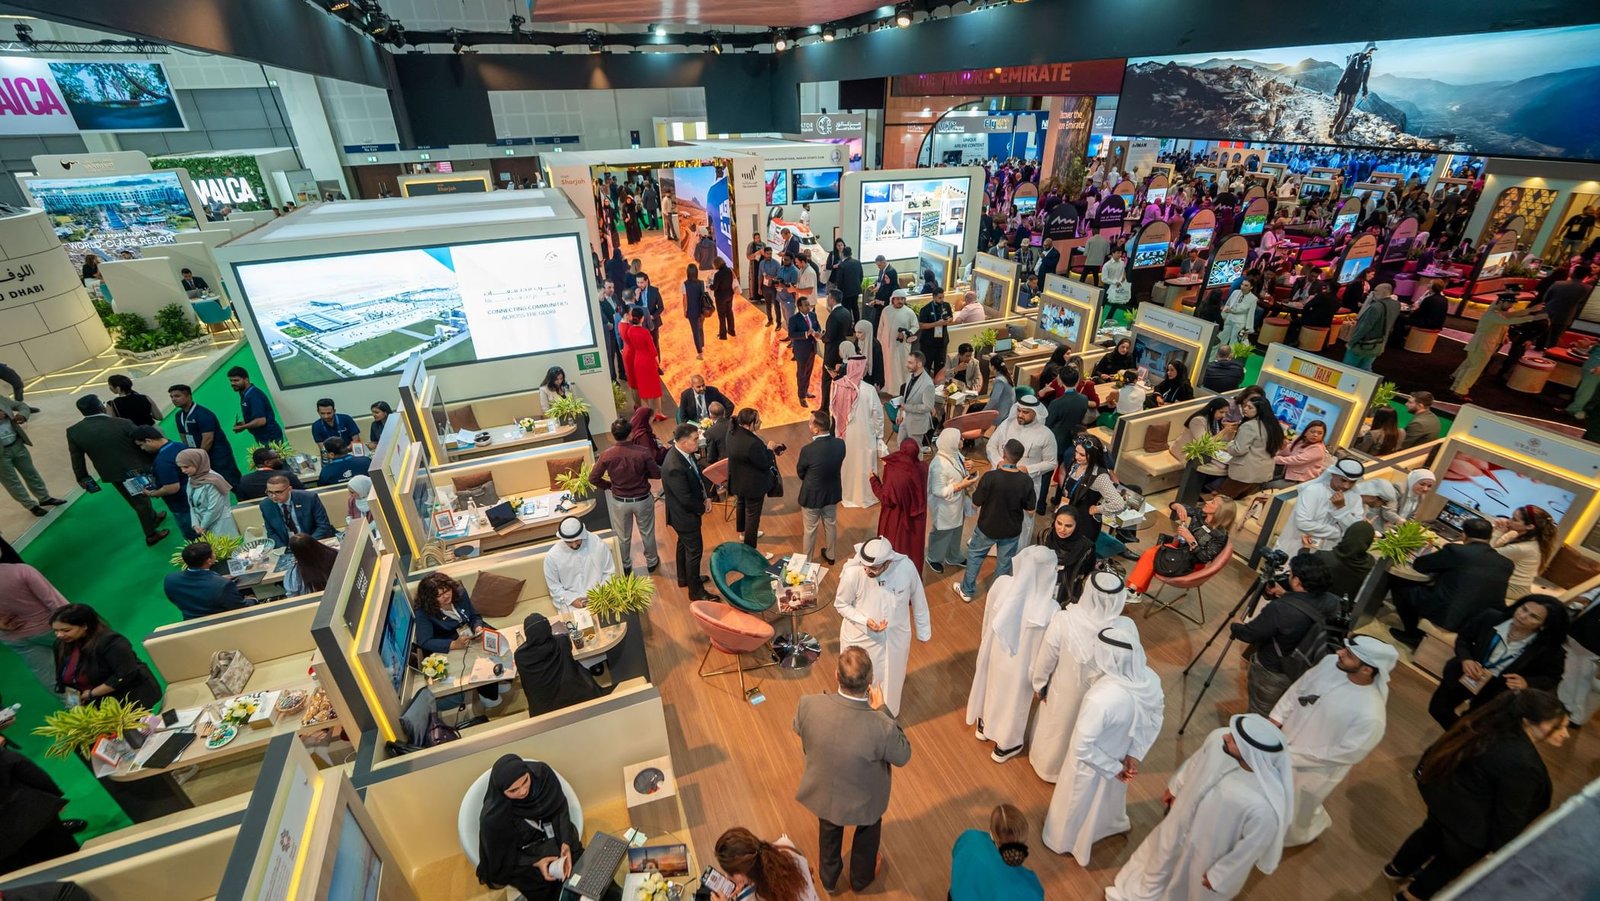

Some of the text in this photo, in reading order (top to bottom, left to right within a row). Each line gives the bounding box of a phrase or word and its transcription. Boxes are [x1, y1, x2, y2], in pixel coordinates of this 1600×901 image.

[1000, 63, 1073, 83] EMIRATE
[561, 178, 586, 186] Sharjah
[68, 238, 138, 250] WORLD-CLASS
[9, 284, 45, 299] DHABI
[487, 301, 569, 315] CONNECTING COMMUNITIES
